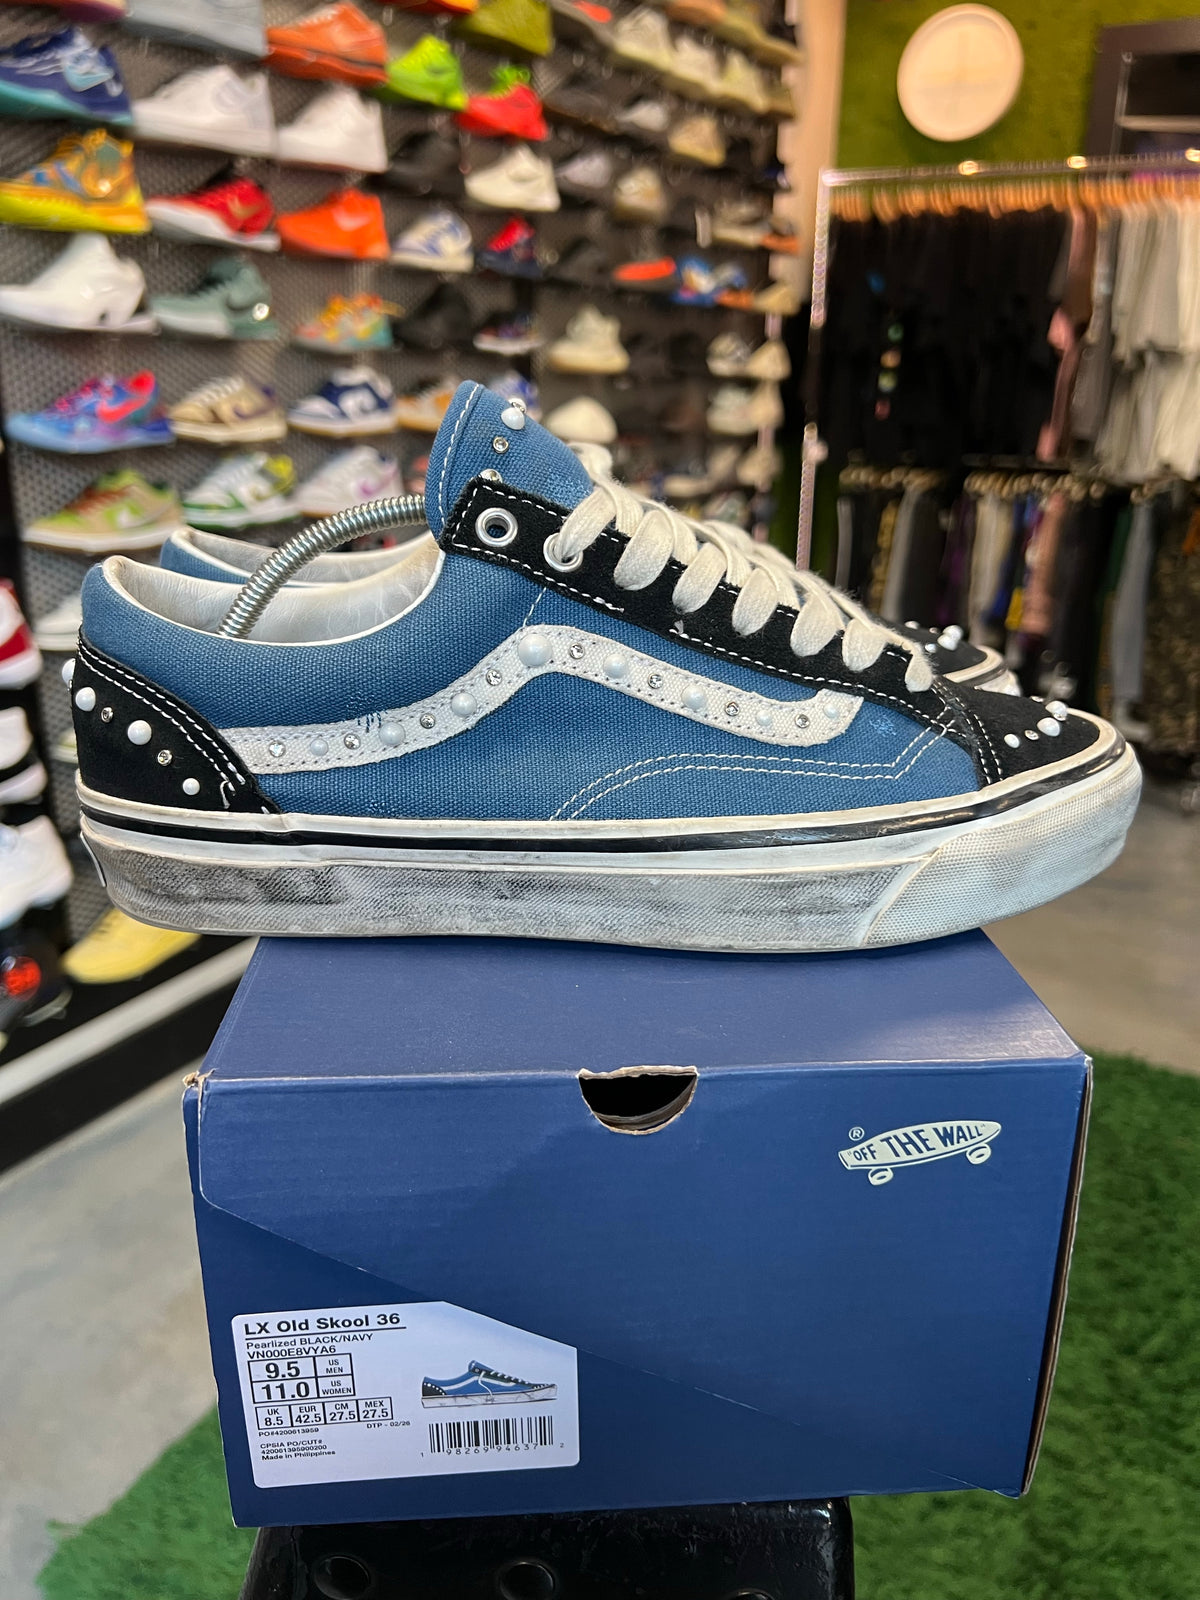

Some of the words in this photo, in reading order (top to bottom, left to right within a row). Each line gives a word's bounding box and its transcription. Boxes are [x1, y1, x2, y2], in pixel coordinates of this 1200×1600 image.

[880, 1129, 936, 1158] THE
[244, 1321, 270, 1335] LX
[276, 1319, 309, 1332] Old
[316, 1315, 370, 1330] Skool
[376, 1313, 401, 1326] 36
[246, 1338, 297, 1350] Pearlized
[300, 1333, 374, 1346] BLACK/NAVY
[247, 1345, 336, 1360] VN000E8VYA6
[328, 1359, 340, 1367] US
[265, 1360, 301, 1379] 9.5
[325, 1366, 344, 1374] MEN
[261, 1381, 310, 1400] 11.0
[321, 1387, 352, 1396] WOMEN
[299, 1405, 317, 1413] EUR
[334, 1402, 349, 1410] CM
[364, 1400, 385, 1408] MEX
[267, 1408, 280, 1416] UK
[329, 1410, 356, 1421] 27.5
[362, 1408, 389, 1419] 27.5
[264, 1416, 284, 1427] 8.5
[295, 1413, 322, 1424] 42.5
[287, 1439, 323, 1447] PO/CUT#
[261, 1453, 283, 1461] Made
[294, 1450, 336, 1458] Philippines
